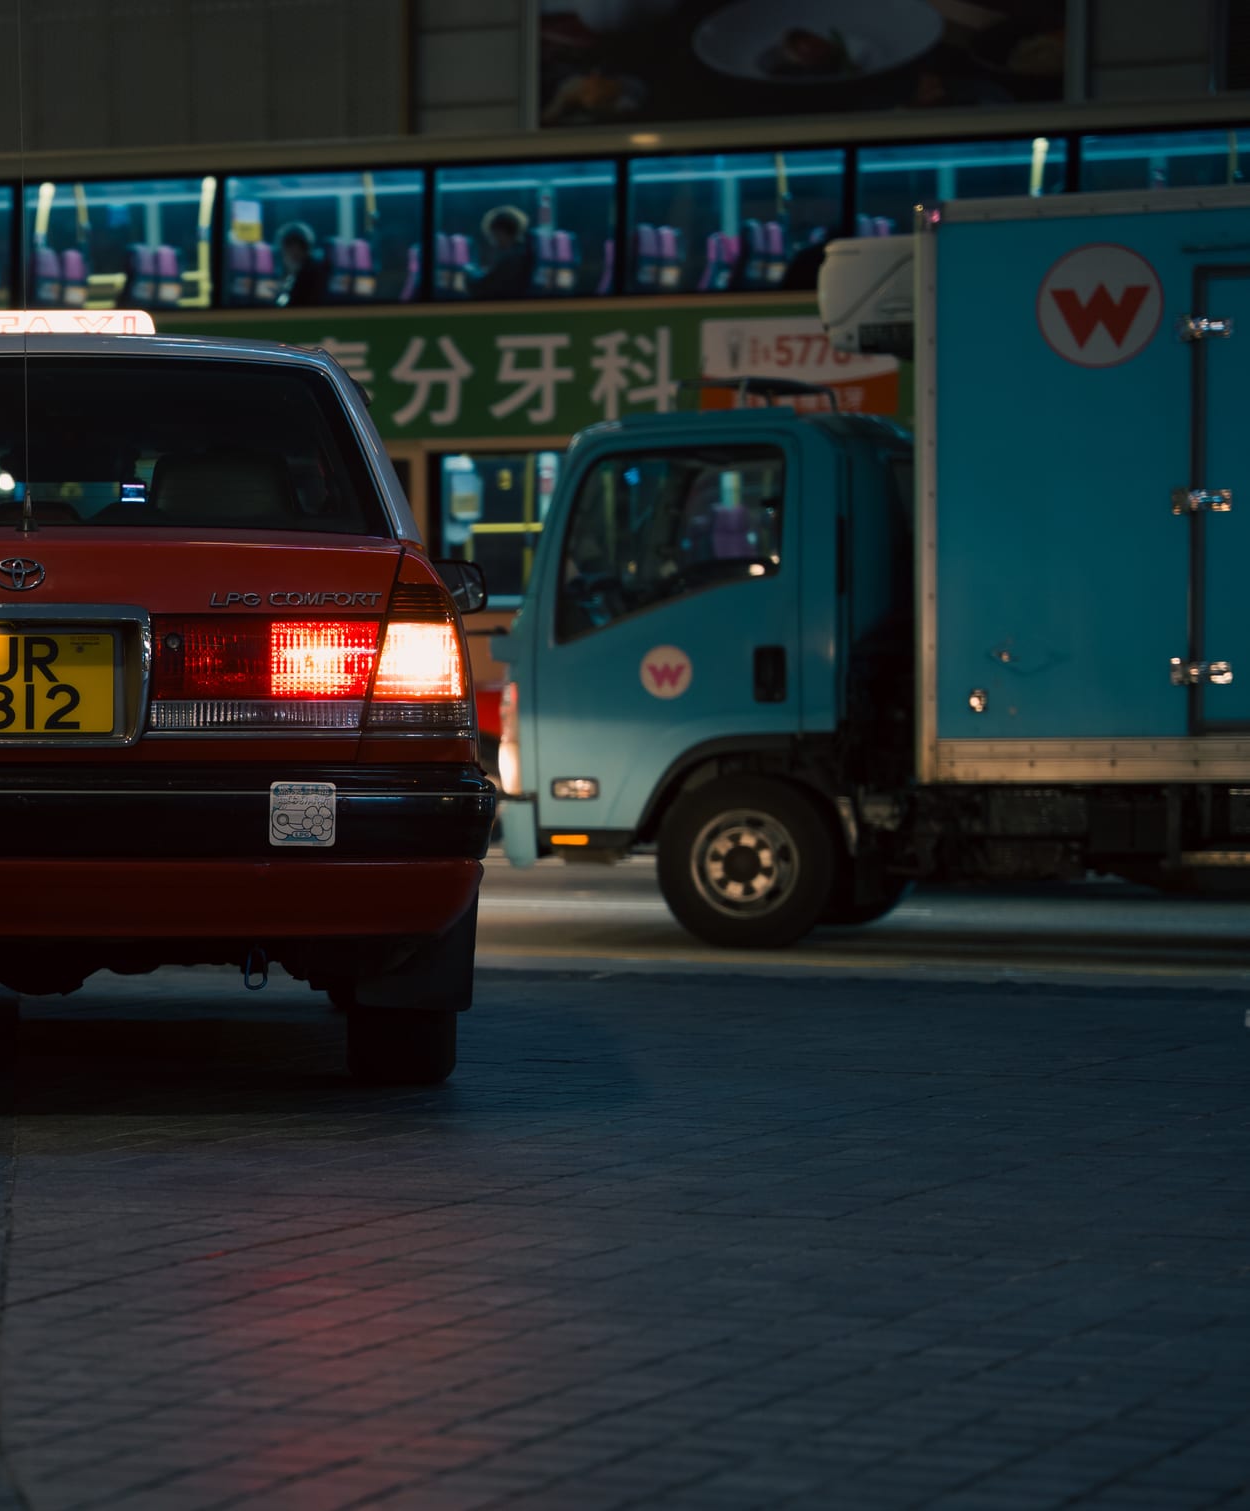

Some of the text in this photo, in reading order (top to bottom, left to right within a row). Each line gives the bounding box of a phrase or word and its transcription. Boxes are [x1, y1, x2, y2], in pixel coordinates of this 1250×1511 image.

[1050, 282, 1151, 350] W
[209, 591, 383, 608] LPG COMFORT
[648, 664, 685, 688] W
